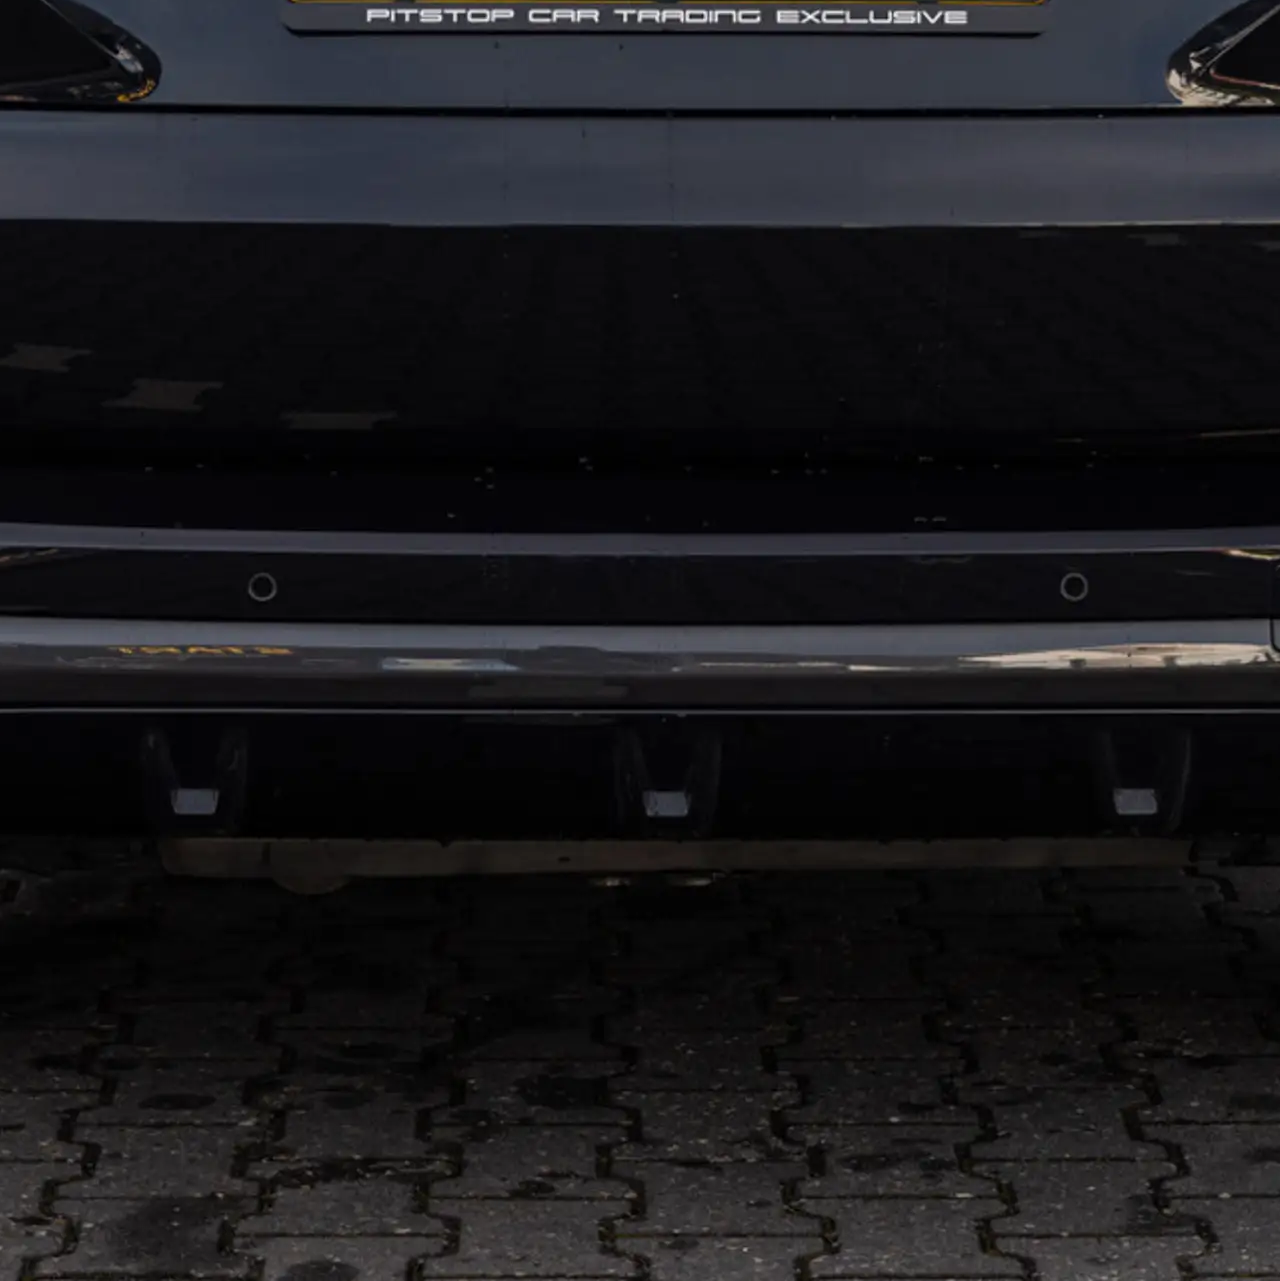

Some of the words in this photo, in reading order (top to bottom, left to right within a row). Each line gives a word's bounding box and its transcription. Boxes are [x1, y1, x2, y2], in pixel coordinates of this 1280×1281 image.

[365, 7, 516, 24] PITSTOP
[527, 7, 601, 24] CAR
[612, 8, 762, 25] TRADING
[775, 8, 969, 25] EXCLUSIVE
